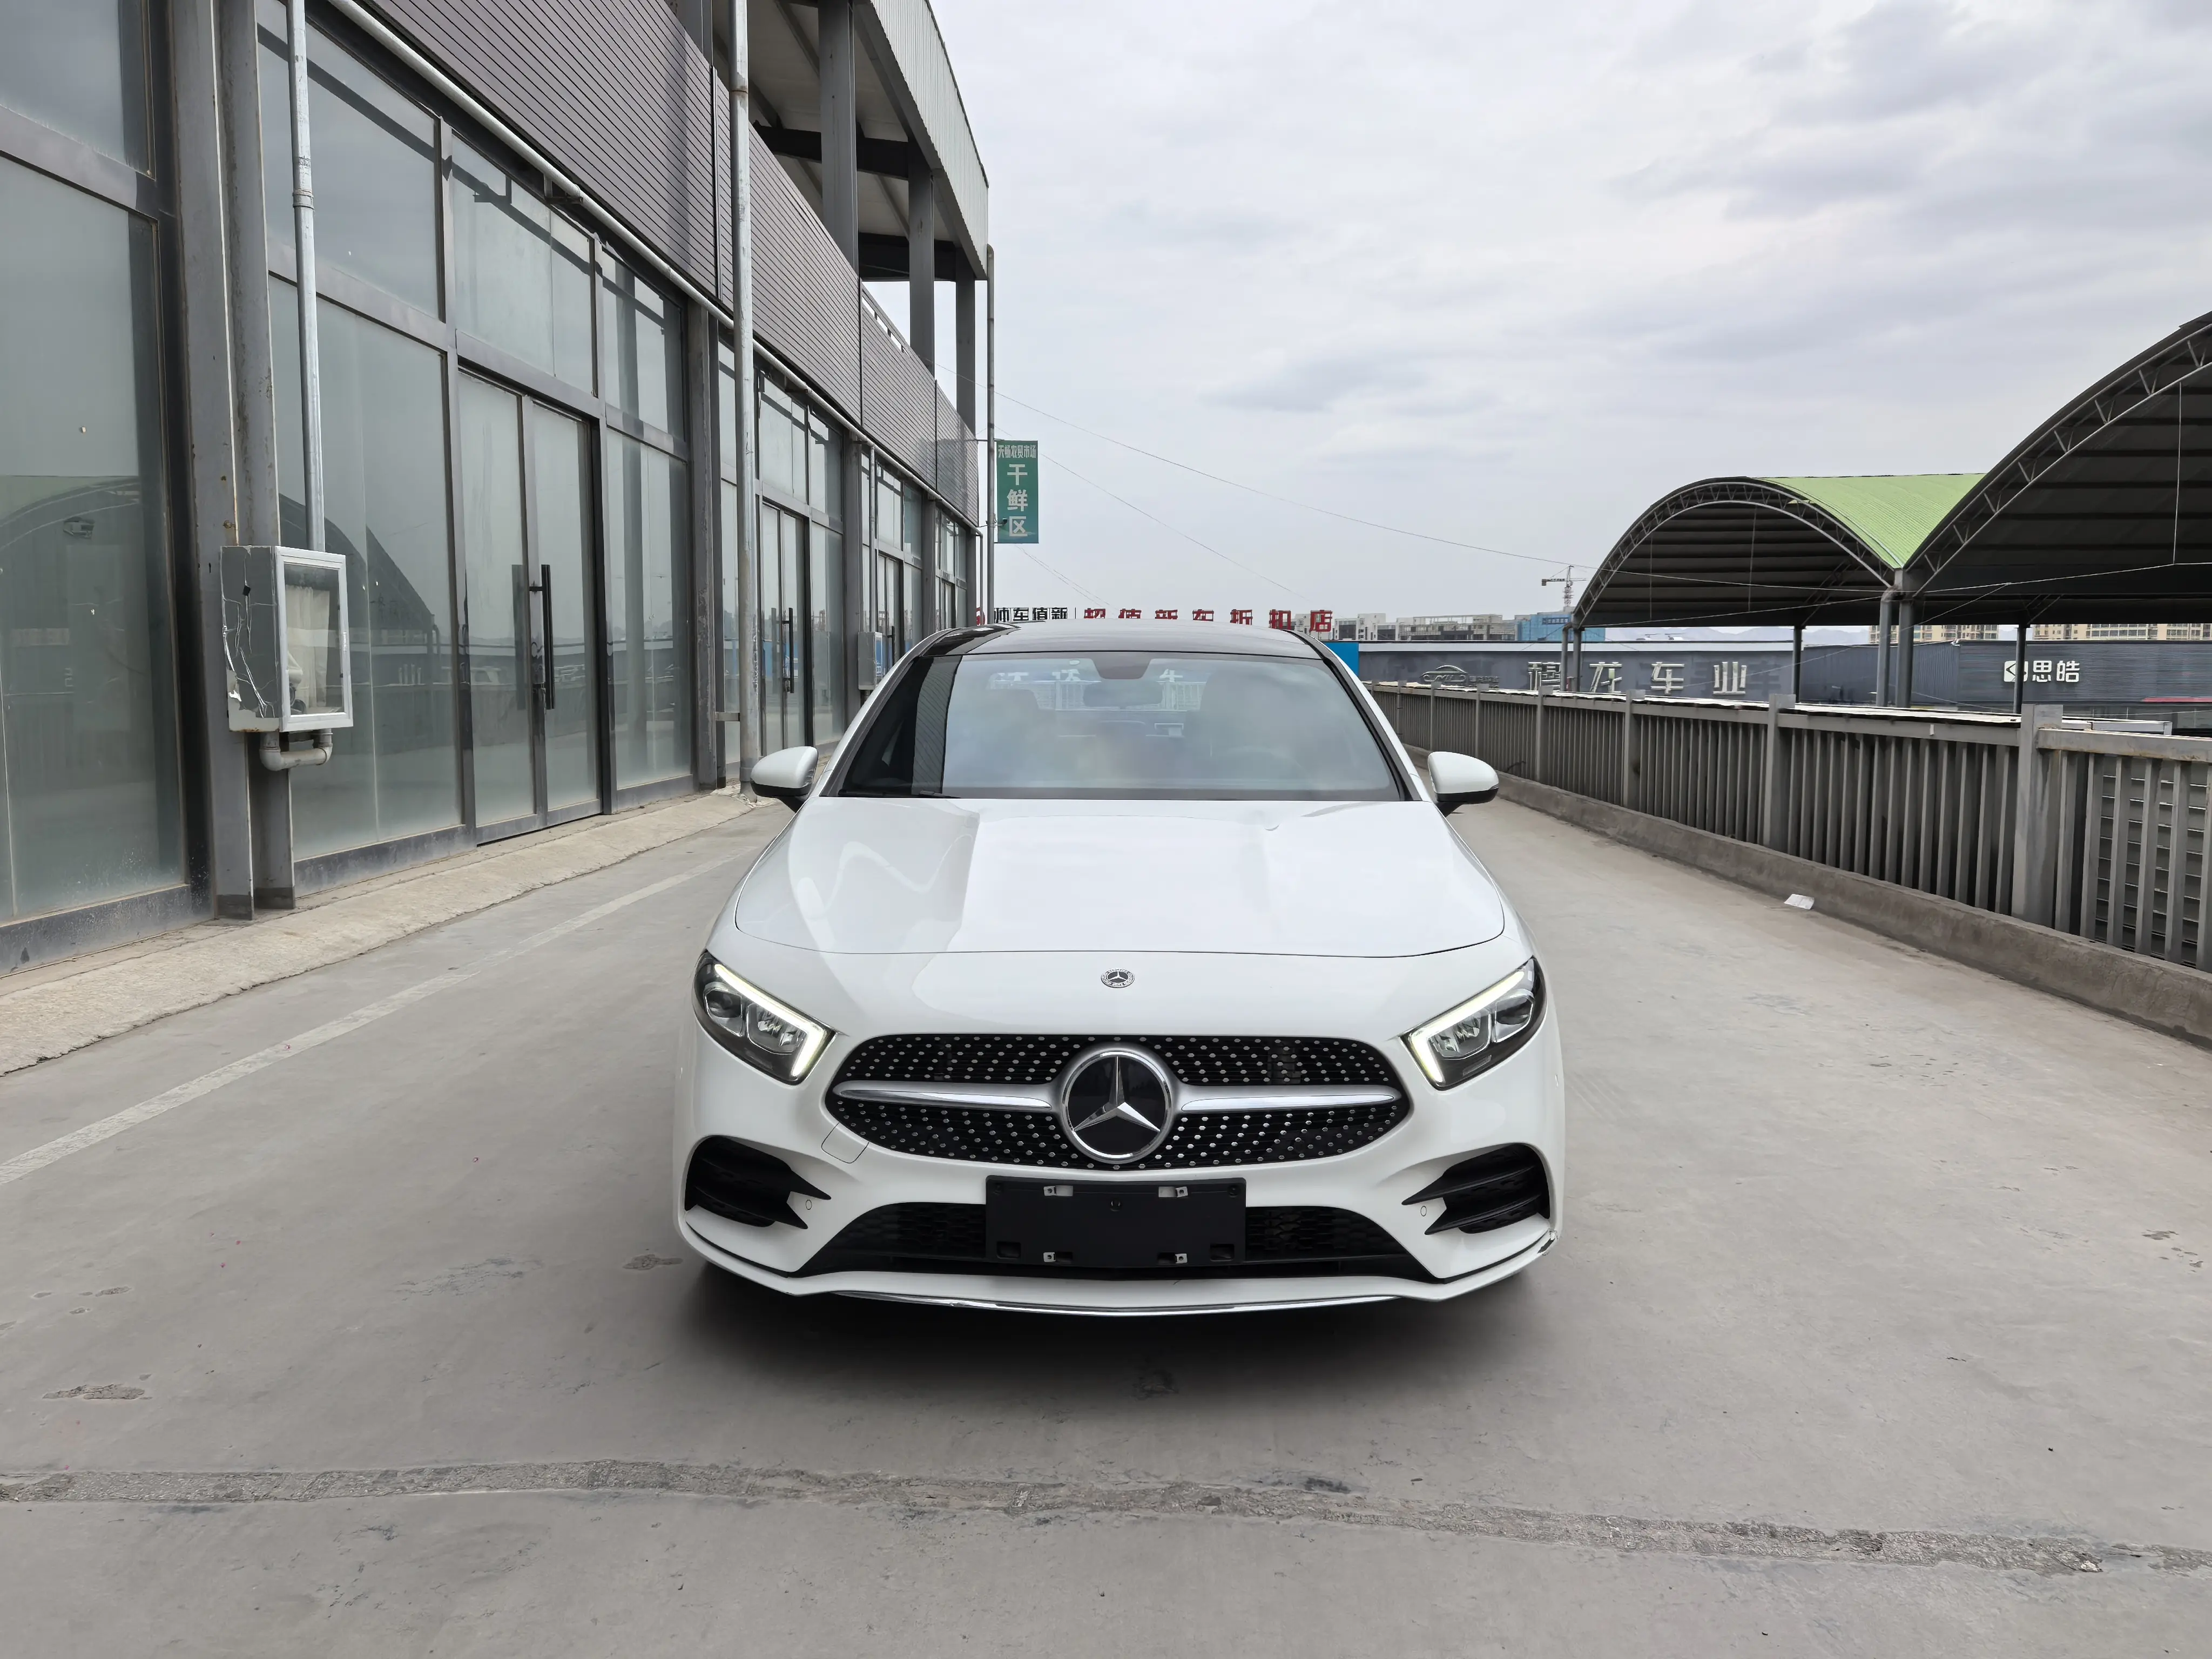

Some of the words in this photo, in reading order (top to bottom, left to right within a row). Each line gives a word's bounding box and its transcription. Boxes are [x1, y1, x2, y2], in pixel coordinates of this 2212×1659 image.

[1007, 464, 1028, 537] 干鲜区
[2032, 660, 2080, 682] 思皓
